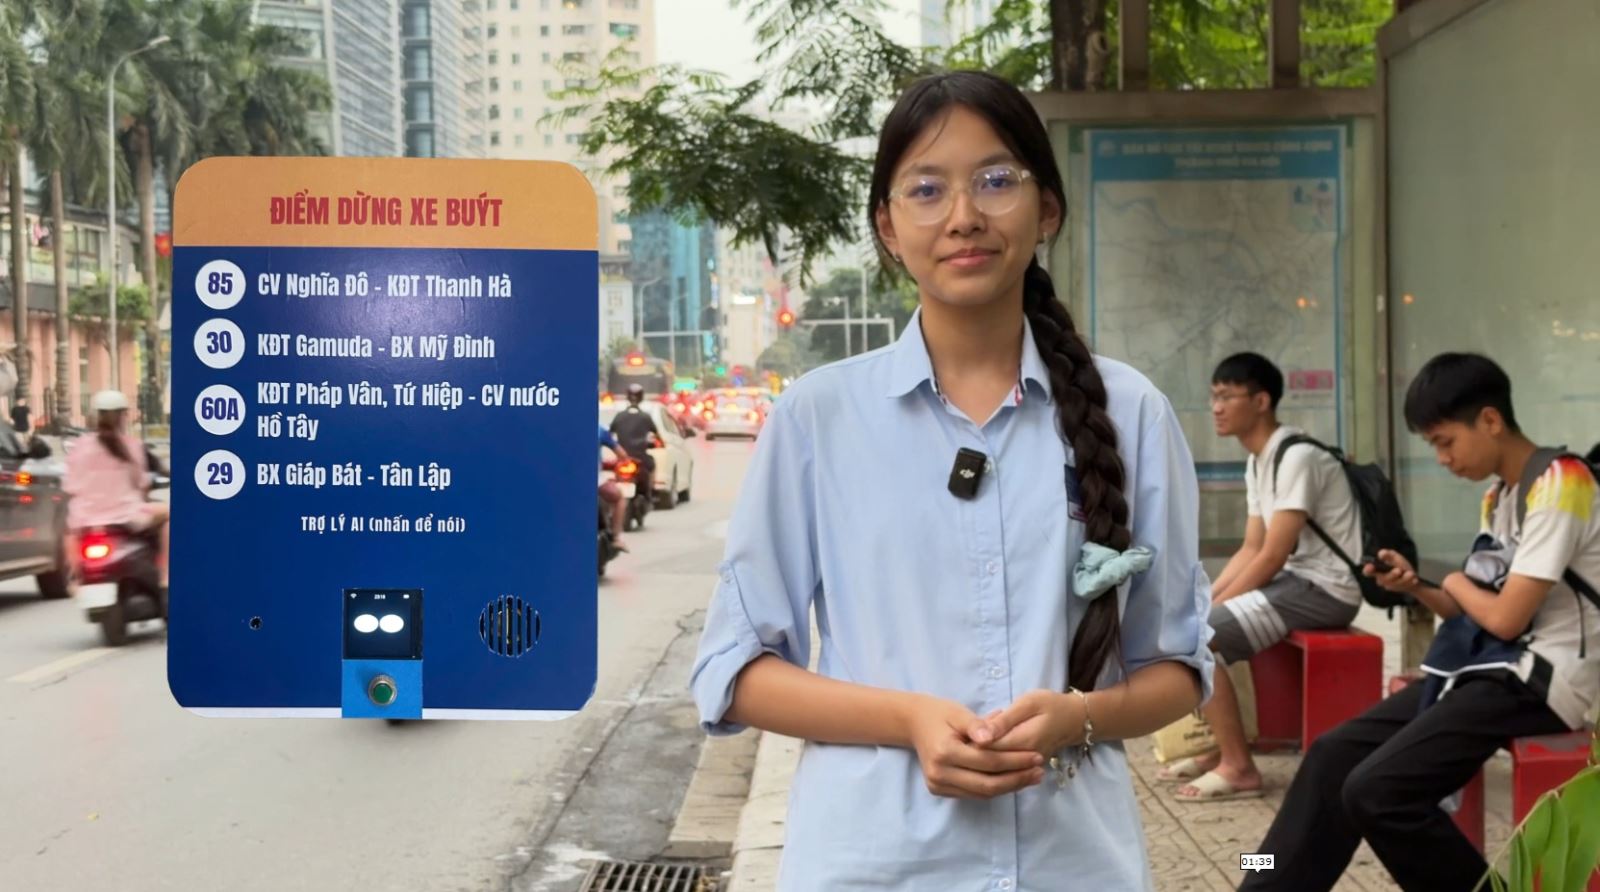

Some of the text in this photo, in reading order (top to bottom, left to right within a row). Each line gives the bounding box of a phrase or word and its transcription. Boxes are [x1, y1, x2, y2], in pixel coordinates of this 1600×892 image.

[270, 189, 503, 227] ĐIỂM DỪNG XE BUÝT
[207, 271, 233, 296] 85
[258, 274, 281, 296] CV
[286, 272, 340, 300] Nghĩa
[344, 271, 370, 297] Đô
[387, 274, 421, 297] KĐT
[425, 274, 482, 297] Thanh
[488, 273, 512, 298] Hà
[206, 330, 233, 355] 30
[257, 333, 291, 356] KĐT
[296, 333, 372, 358] Gamuda
[391, 335, 415, 358] BX
[419, 332, 448, 362] Mỹ
[453, 333, 495, 358] Đình
[200, 397, 240, 421] 60A
[257, 382, 291, 404] KĐT
[296, 380, 343, 409] Pháp
[347, 380, 388, 409] Vân,
[393, 381, 417, 406] Tứ
[421, 381, 463, 411] Hiệp
[481, 384, 505, 406] CV
[509, 381, 560, 407] nước
[257, 411, 319, 441] Hồ Tây
[207, 461, 233, 486] 29
[257, 463, 280, 485] BX
[286, 461, 326, 489] Giáp
[332, 462, 362, 486] Bát
[380, 462, 413, 487] Tân
[418, 462, 451, 492] Lập
[301, 512, 466, 534] TRỢ LÝ AI (nhấn để nói)
